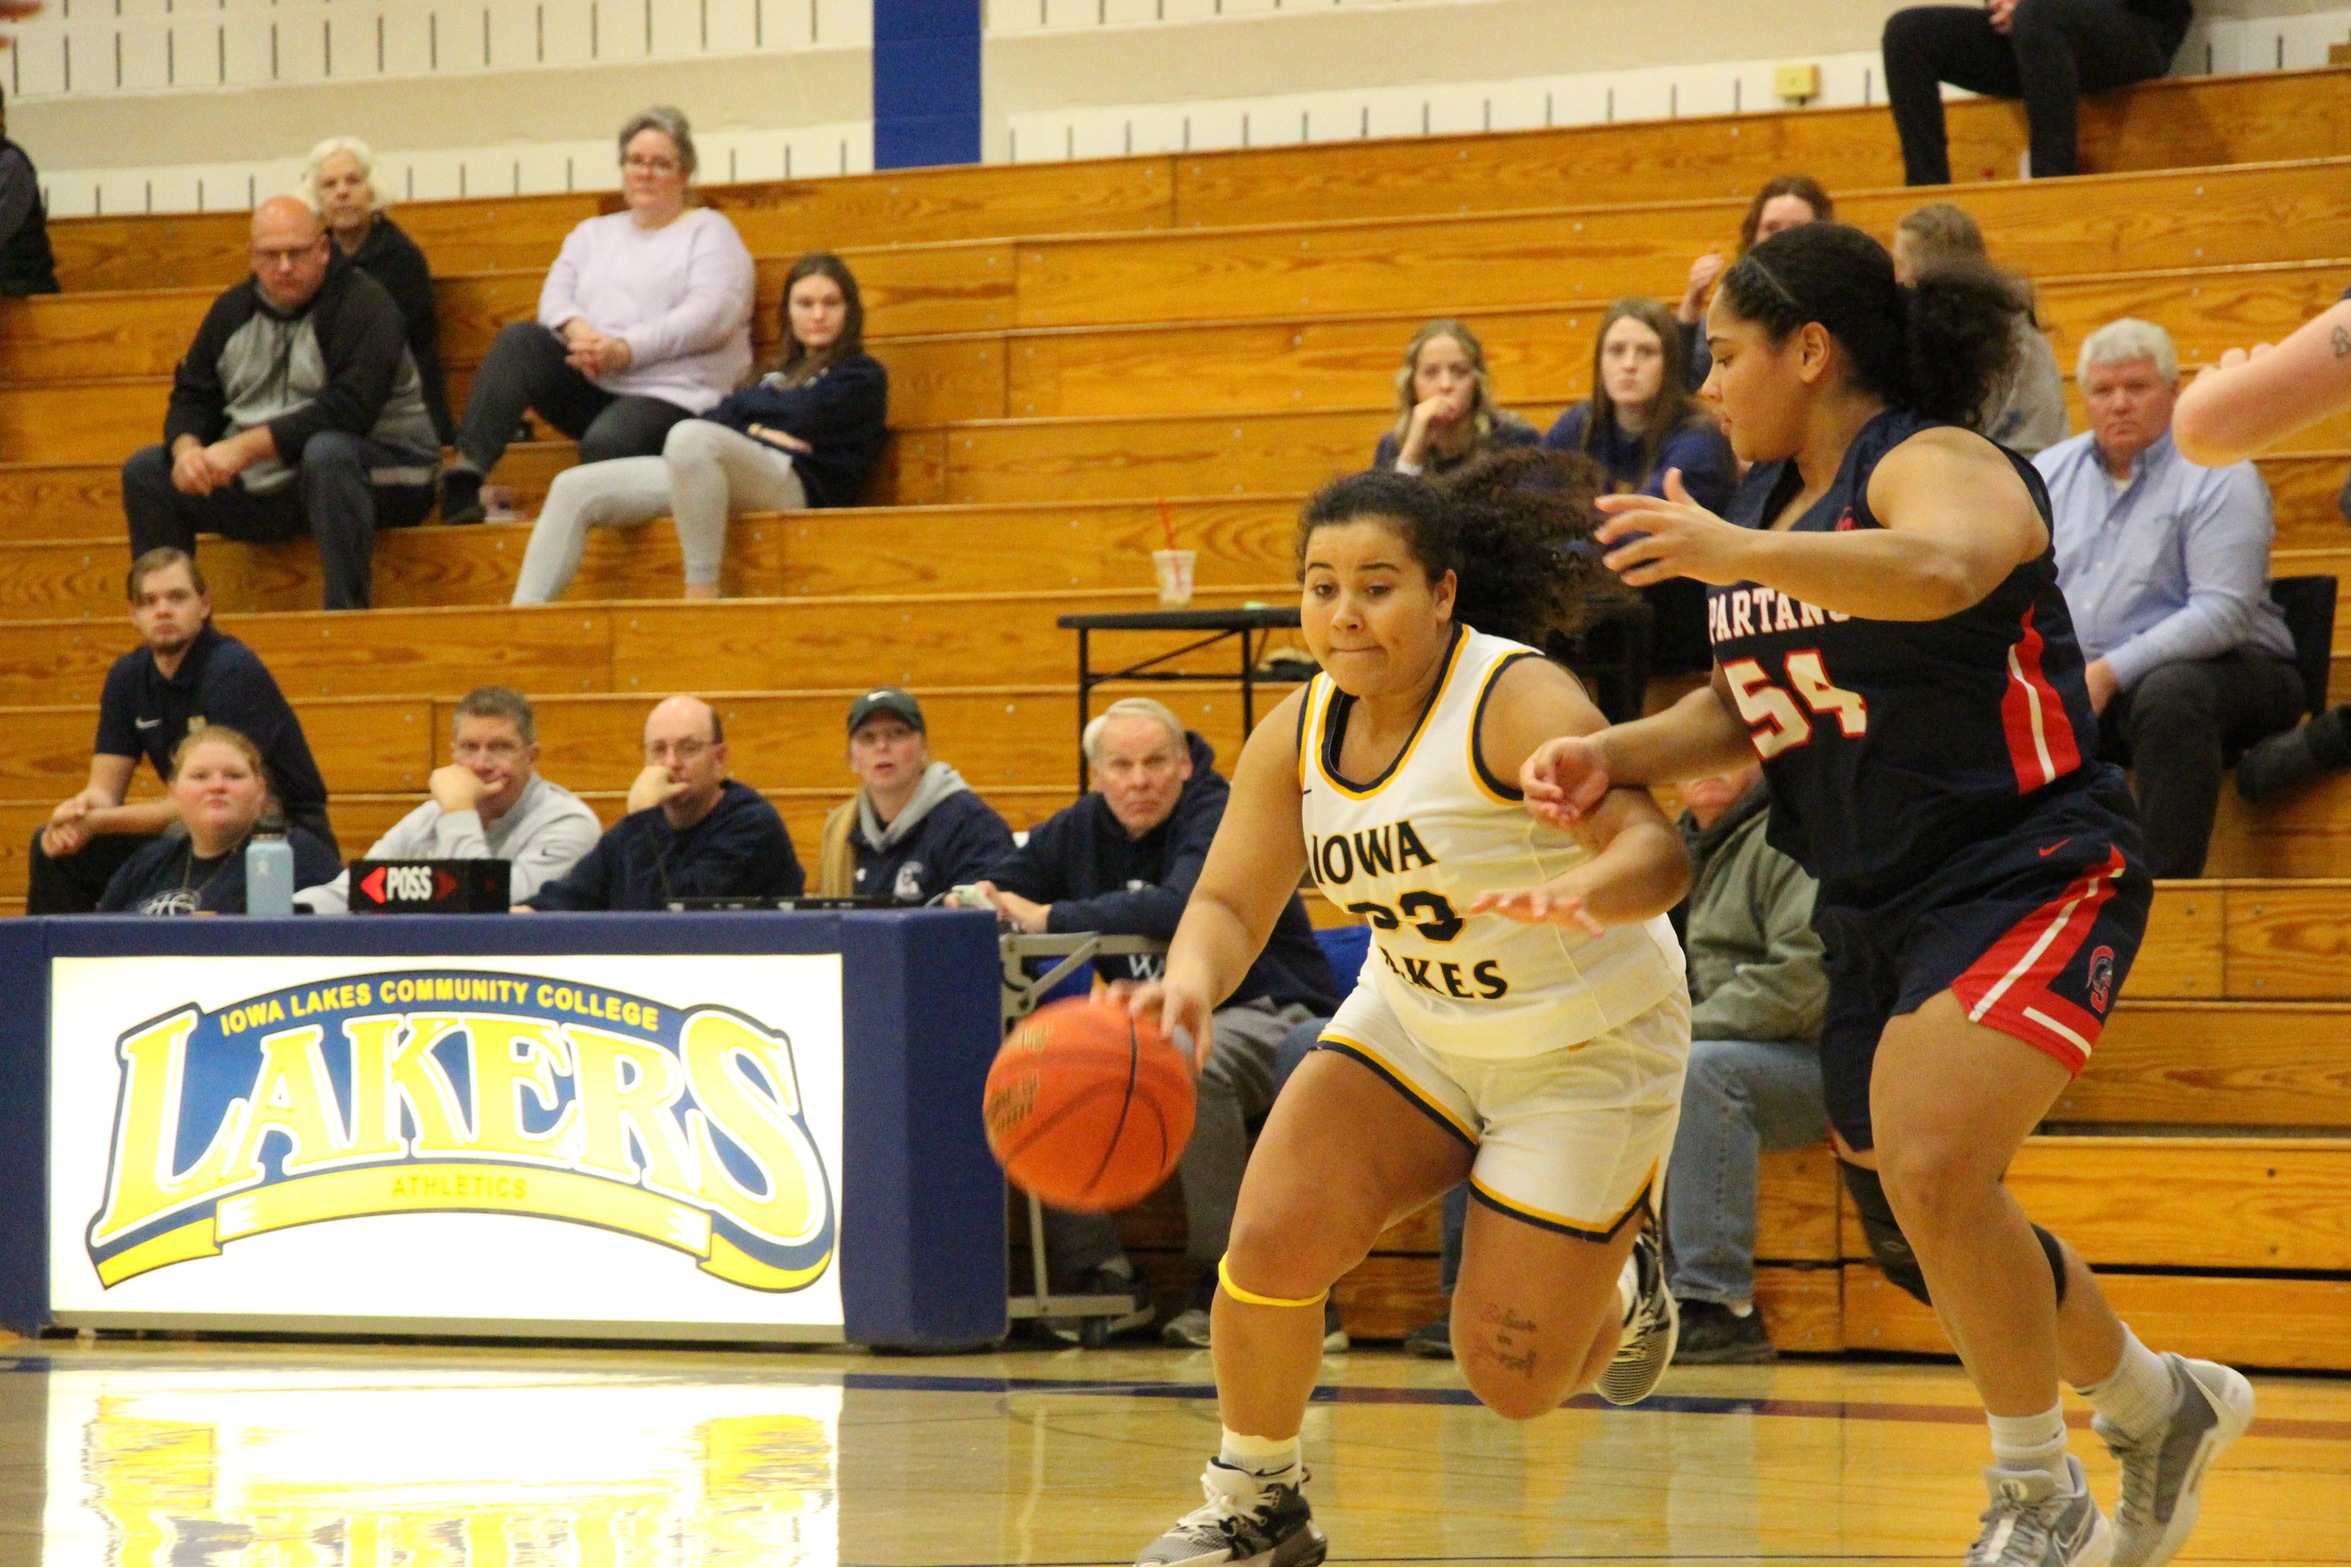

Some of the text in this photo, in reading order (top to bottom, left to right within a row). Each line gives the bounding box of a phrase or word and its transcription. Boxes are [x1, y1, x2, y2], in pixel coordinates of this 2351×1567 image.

[1708, 586, 1851, 646] PARTAN
[1722, 648, 1868, 762] 54
[1311, 819, 1439, 885] IOWA
[386, 865, 433, 901] POSS
[219, 977, 660, 1036] IOWA LAKES COMMUNITY COLLEGE
[91, 1007, 826, 1247] LAKERS
[391, 1175, 527, 1200] ATHLETICS
